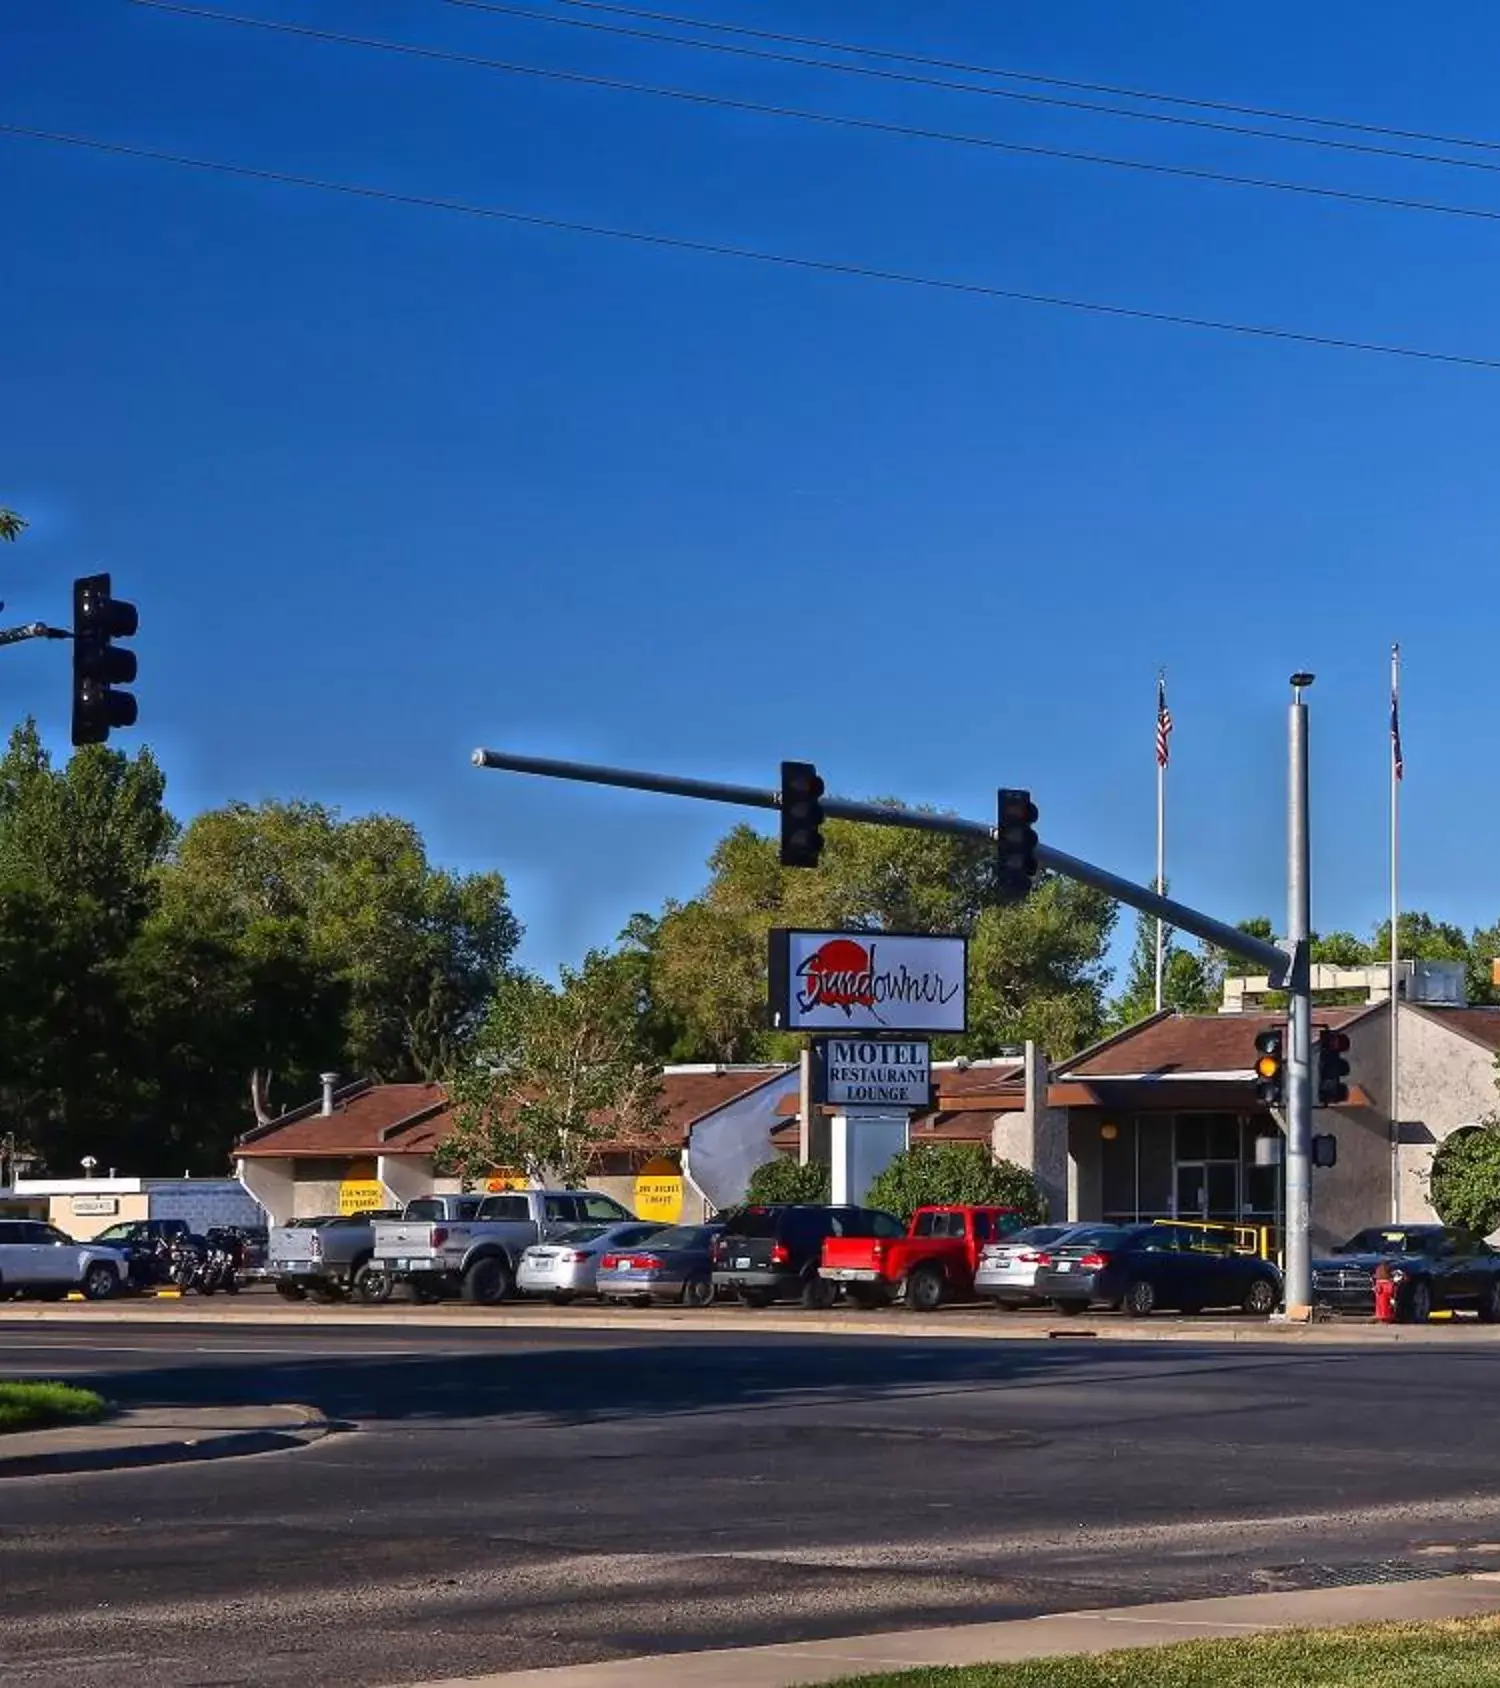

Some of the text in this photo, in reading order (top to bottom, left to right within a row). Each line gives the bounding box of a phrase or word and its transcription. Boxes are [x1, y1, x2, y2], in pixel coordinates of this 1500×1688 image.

[797, 944, 959, 1016] Sundowner
[834, 1043, 922, 1064] MOTEL
[830, 1067, 927, 1083] RESTAURANT
[847, 1086, 909, 1100] LOUNGE
